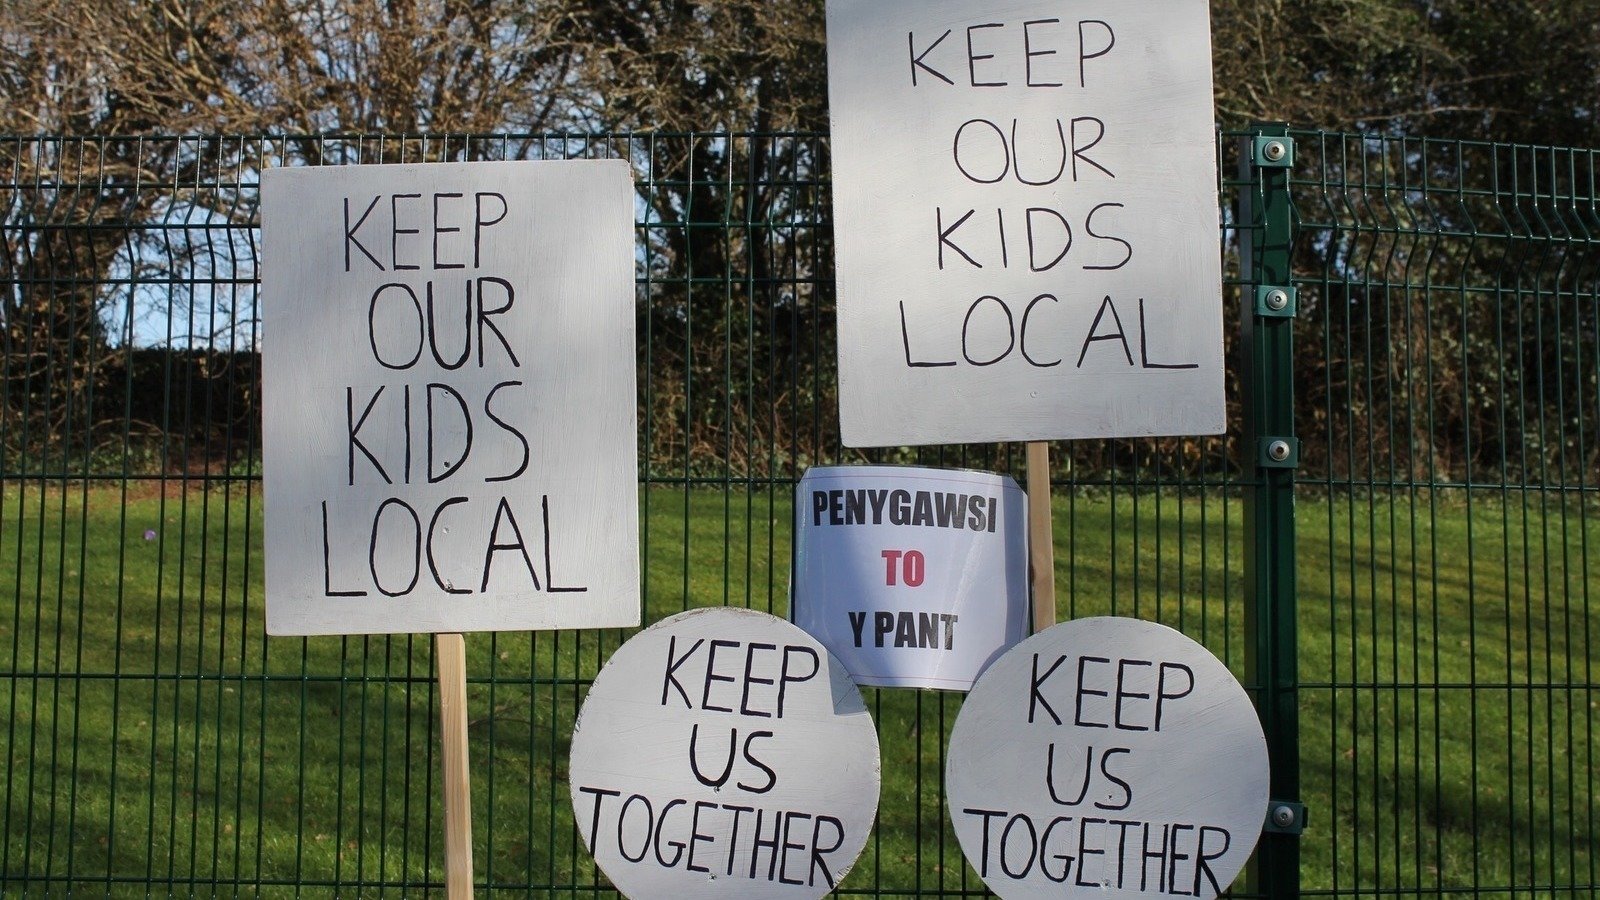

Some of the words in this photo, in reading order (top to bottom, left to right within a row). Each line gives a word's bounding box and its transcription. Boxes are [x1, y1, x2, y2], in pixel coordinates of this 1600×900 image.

[909, 19, 1115, 87] KEEP
[954, 117, 1115, 186] OUR
[344, 193, 507, 272] KEEP
[937, 203, 1132, 272] KIDS
[369, 277, 520, 370] OUR
[900, 294, 1199, 369] LOCAL
[347, 381, 529, 486] KIDS
[322, 495, 587, 597] LOCAL
[813, 489, 997, 533] PENYGAWSI
[881, 549, 925, 587] TO
[848, 611, 867, 648] Y
[875, 611, 958, 650] PANT
[662, 635, 820, 718] KEEP
[1028, 653, 1194, 732] KEEP
[690, 724, 777, 793] US
[1047, 743, 1132, 810] US
[579, 786, 844, 888] TOGETHER
[963, 808, 1231, 898] TOGETHER
